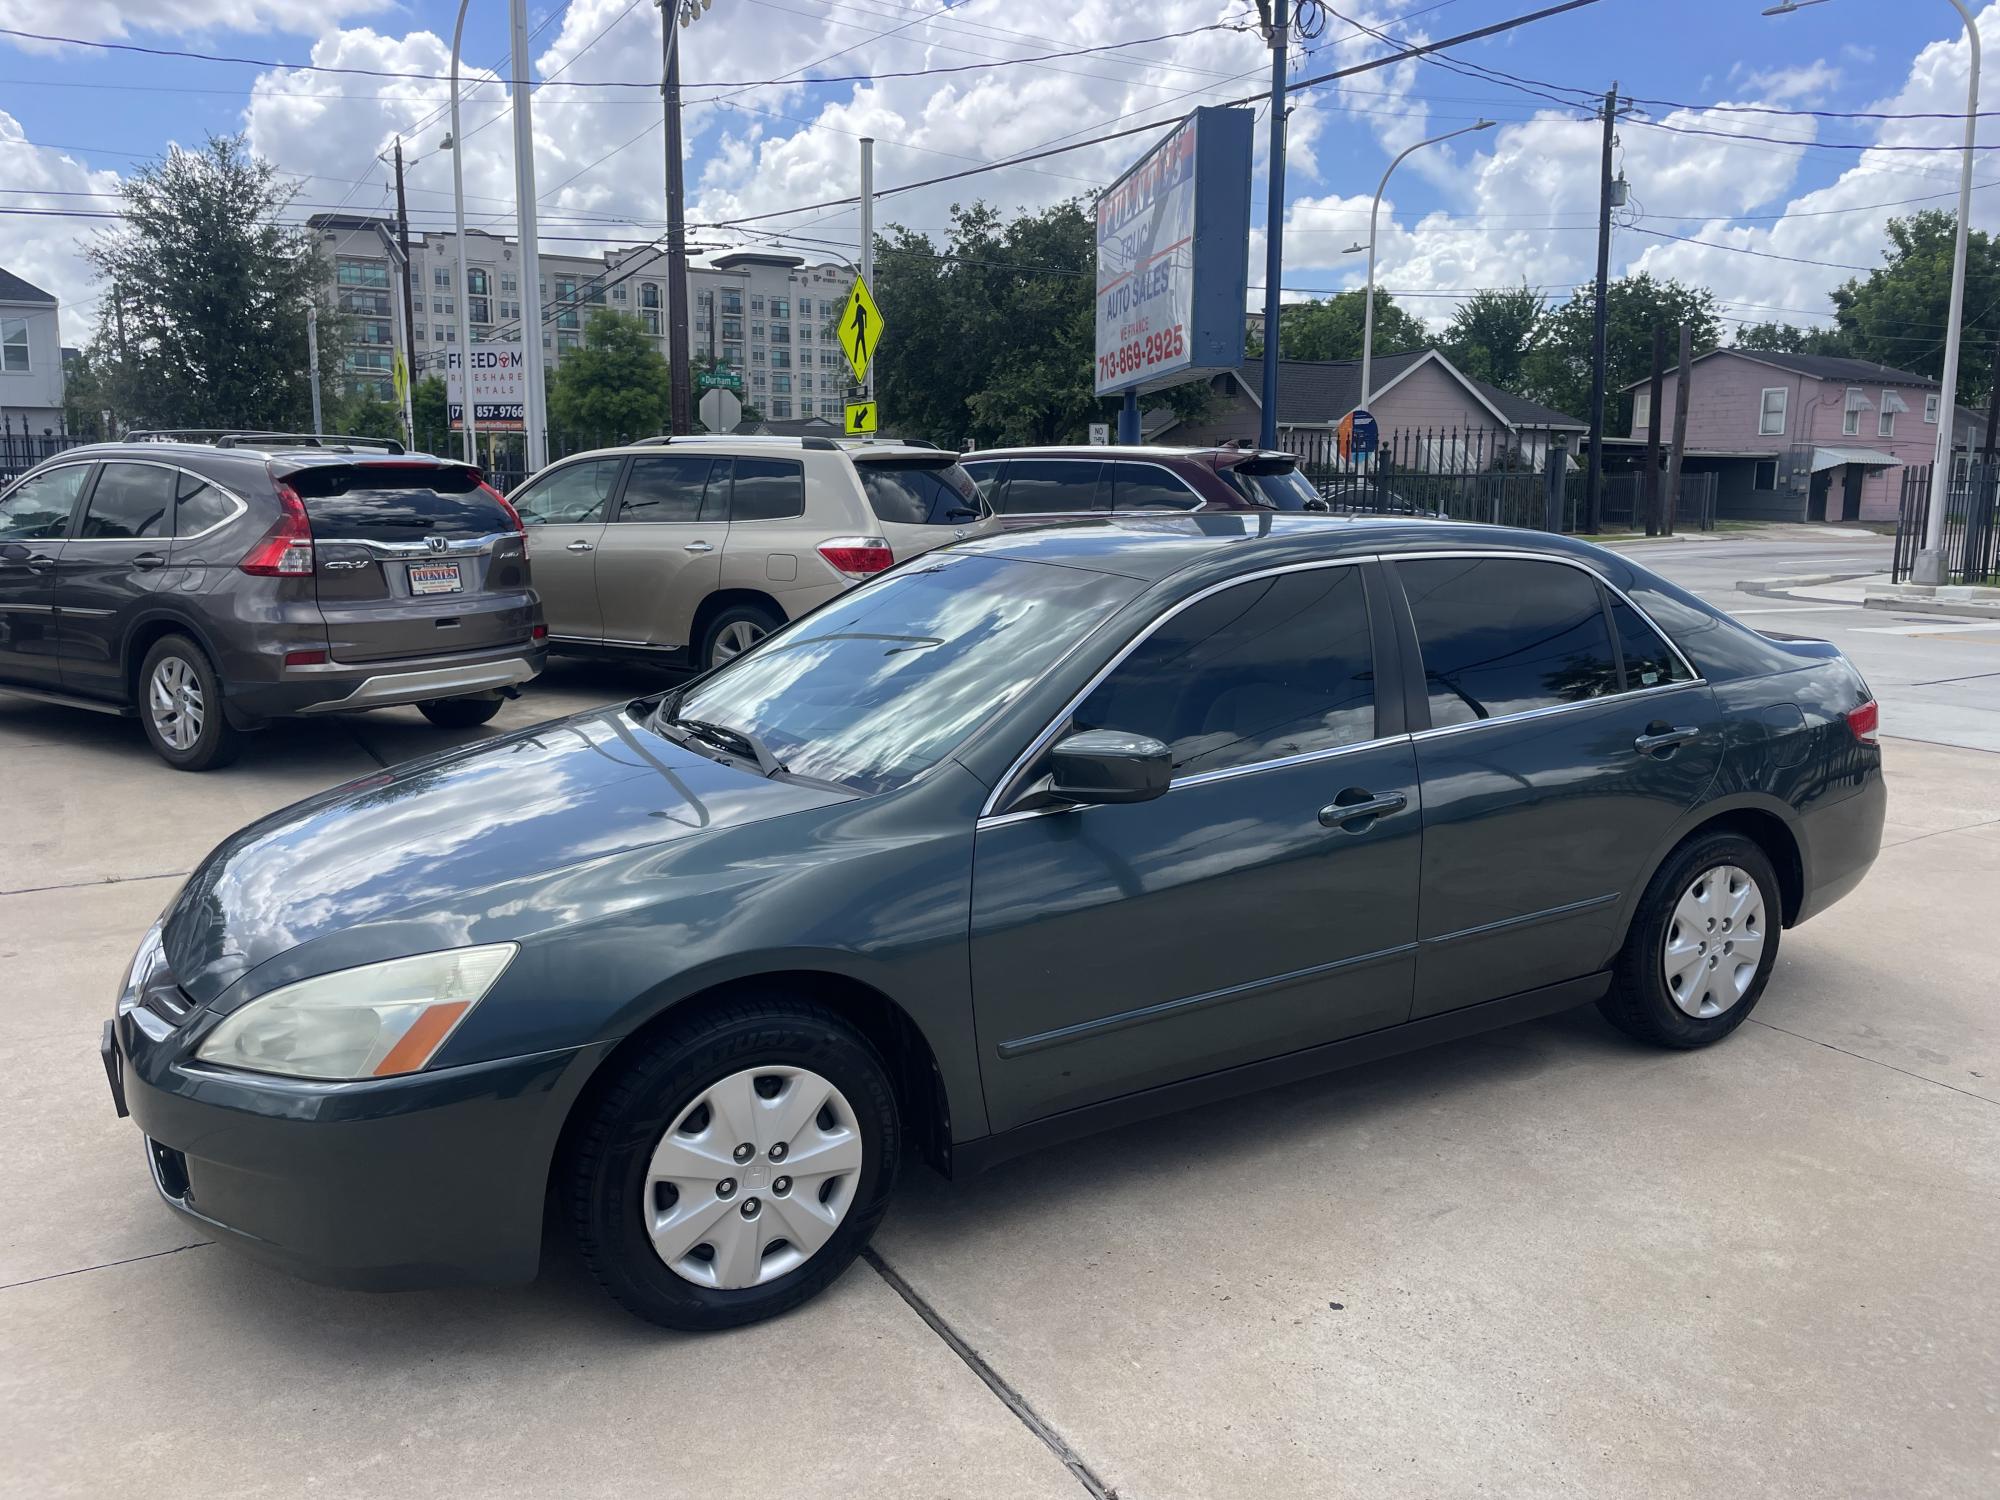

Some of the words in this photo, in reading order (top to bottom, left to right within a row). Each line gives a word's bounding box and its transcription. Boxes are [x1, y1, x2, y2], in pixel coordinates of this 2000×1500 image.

[1107, 283, 1130, 321] AUTO
[1132, 260, 1169, 307] SALES
[1099, 324, 1184, 382] 713-869-2925
[451, 373, 523, 382] RIESHARE
[705, 375, 731, 385] Durham
[1095, 427, 1103, 435] NO
[325, 560, 369, 569] CR-V
[415, 570, 455, 581] FUENTES
